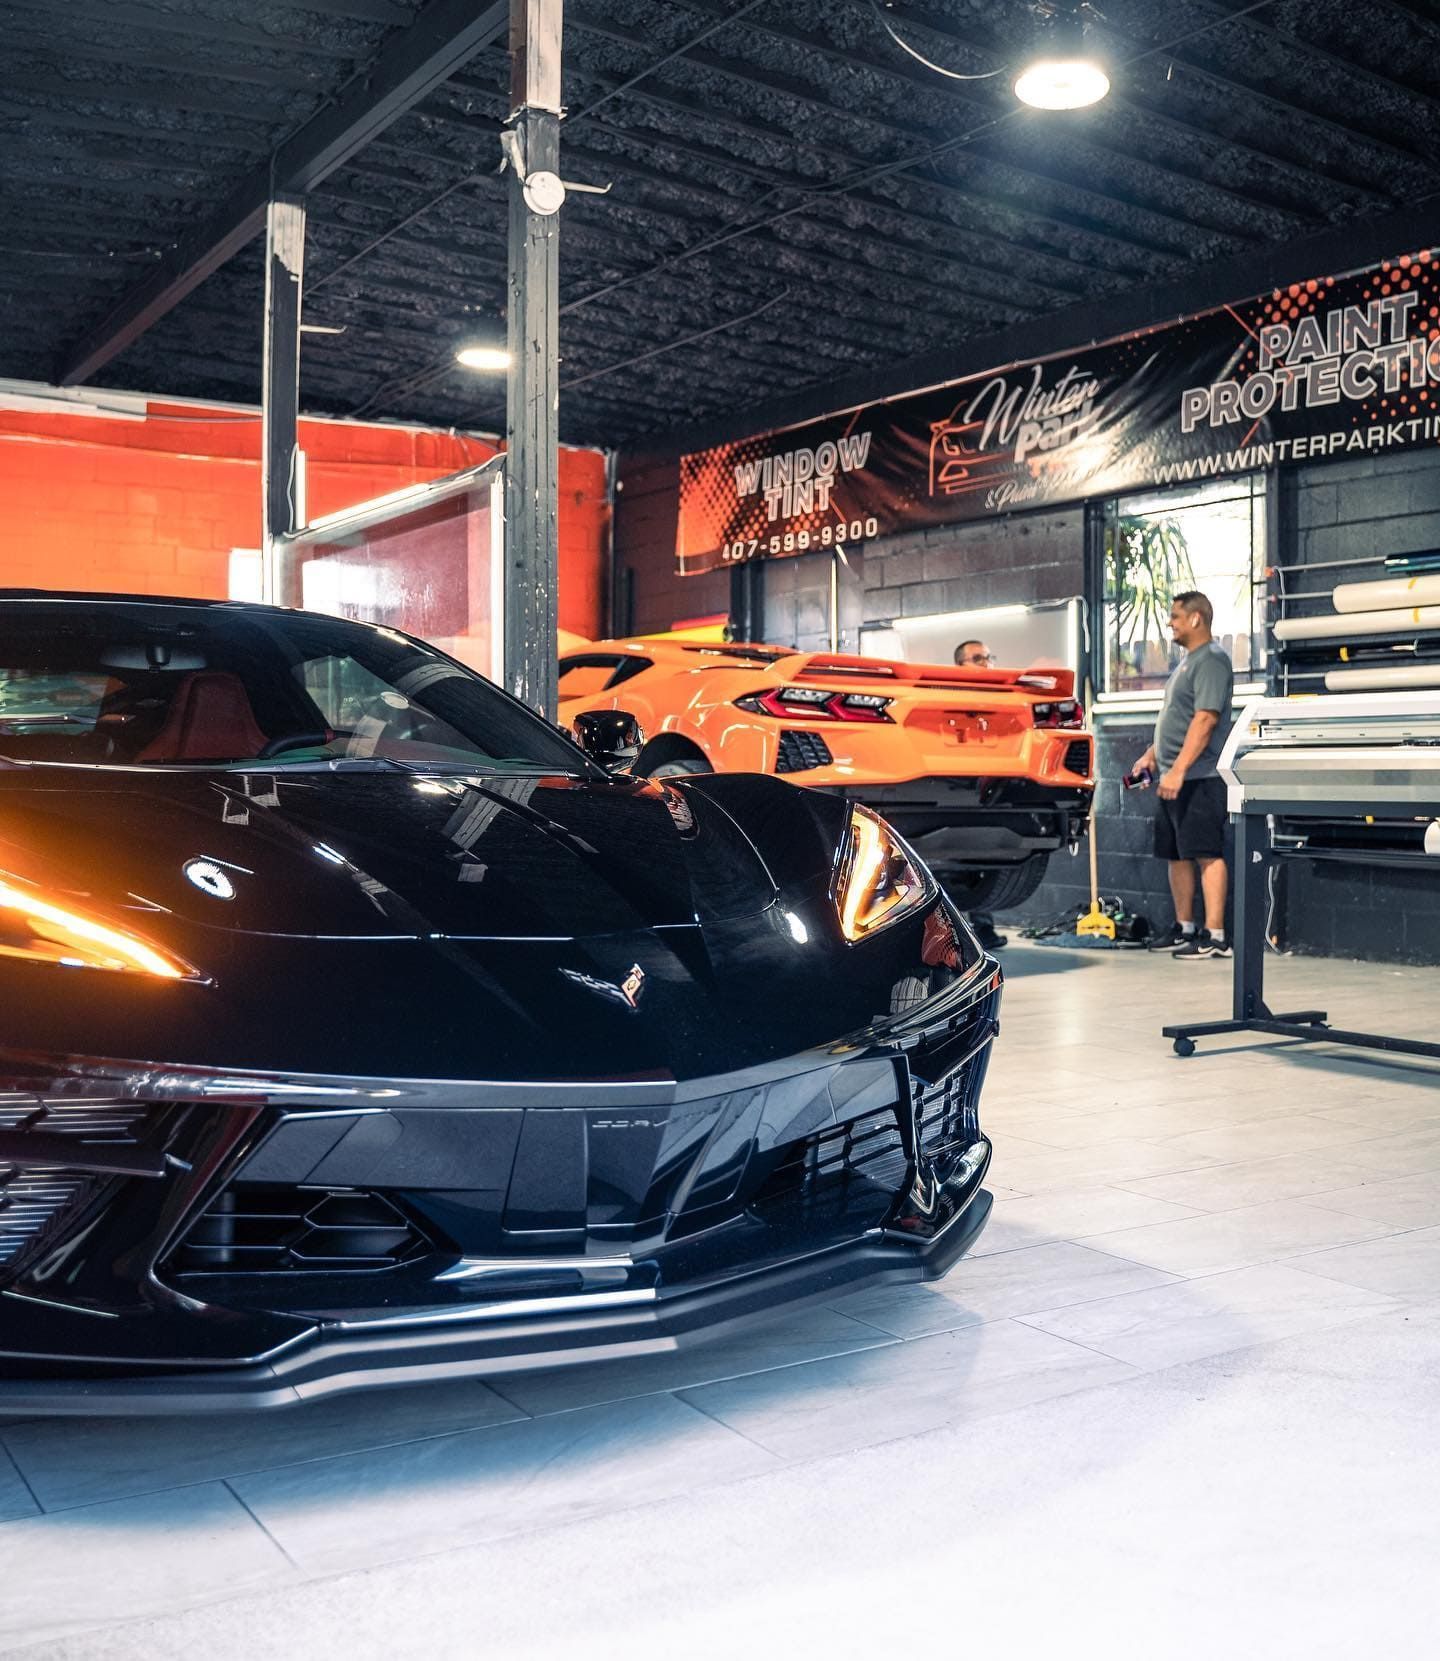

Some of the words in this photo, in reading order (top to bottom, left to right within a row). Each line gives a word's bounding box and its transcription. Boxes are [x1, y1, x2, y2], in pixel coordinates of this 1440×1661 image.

[1259, 290, 1419, 372] PAINT
[963, 364, 1102, 451] Winter
[734, 431, 872, 497] WINDOW
[764, 474, 835, 522] TINT
[721, 517, 878, 560] 407-599-9300
